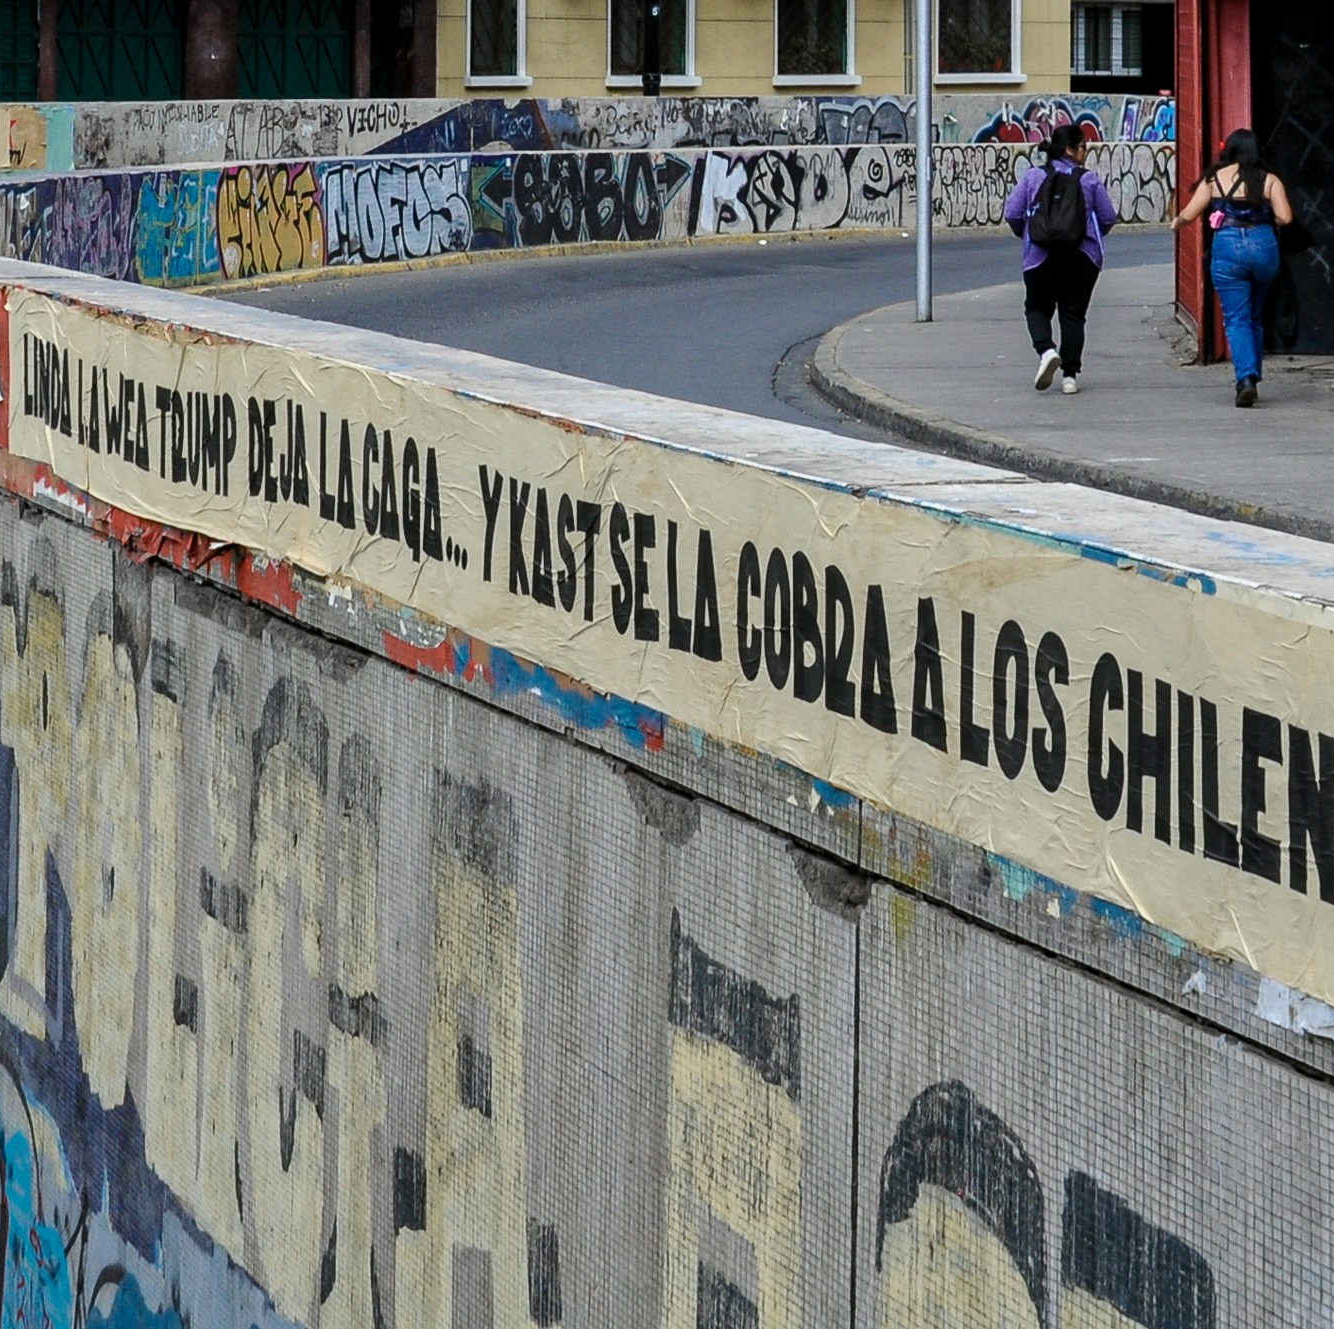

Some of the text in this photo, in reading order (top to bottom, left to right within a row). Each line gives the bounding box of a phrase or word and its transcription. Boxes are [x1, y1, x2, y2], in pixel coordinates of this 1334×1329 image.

[23, 333, 72, 438] LINDA
[78, 358, 100, 453] LA
[103, 368, 150, 472] WEA
[156, 385, 237, 497] TRUMP
[248, 396, 310, 508] DEJA
[320, 411, 356, 530] LA
[478, 464, 504, 582] Y
[509, 476, 602, 622] KAST
[610, 501, 659, 641] SE
[667, 520, 723, 662] LA
[736, 540, 898, 735] COBRA
[911, 596, 948, 753] A
[959, 610, 1069, 793] LOS
